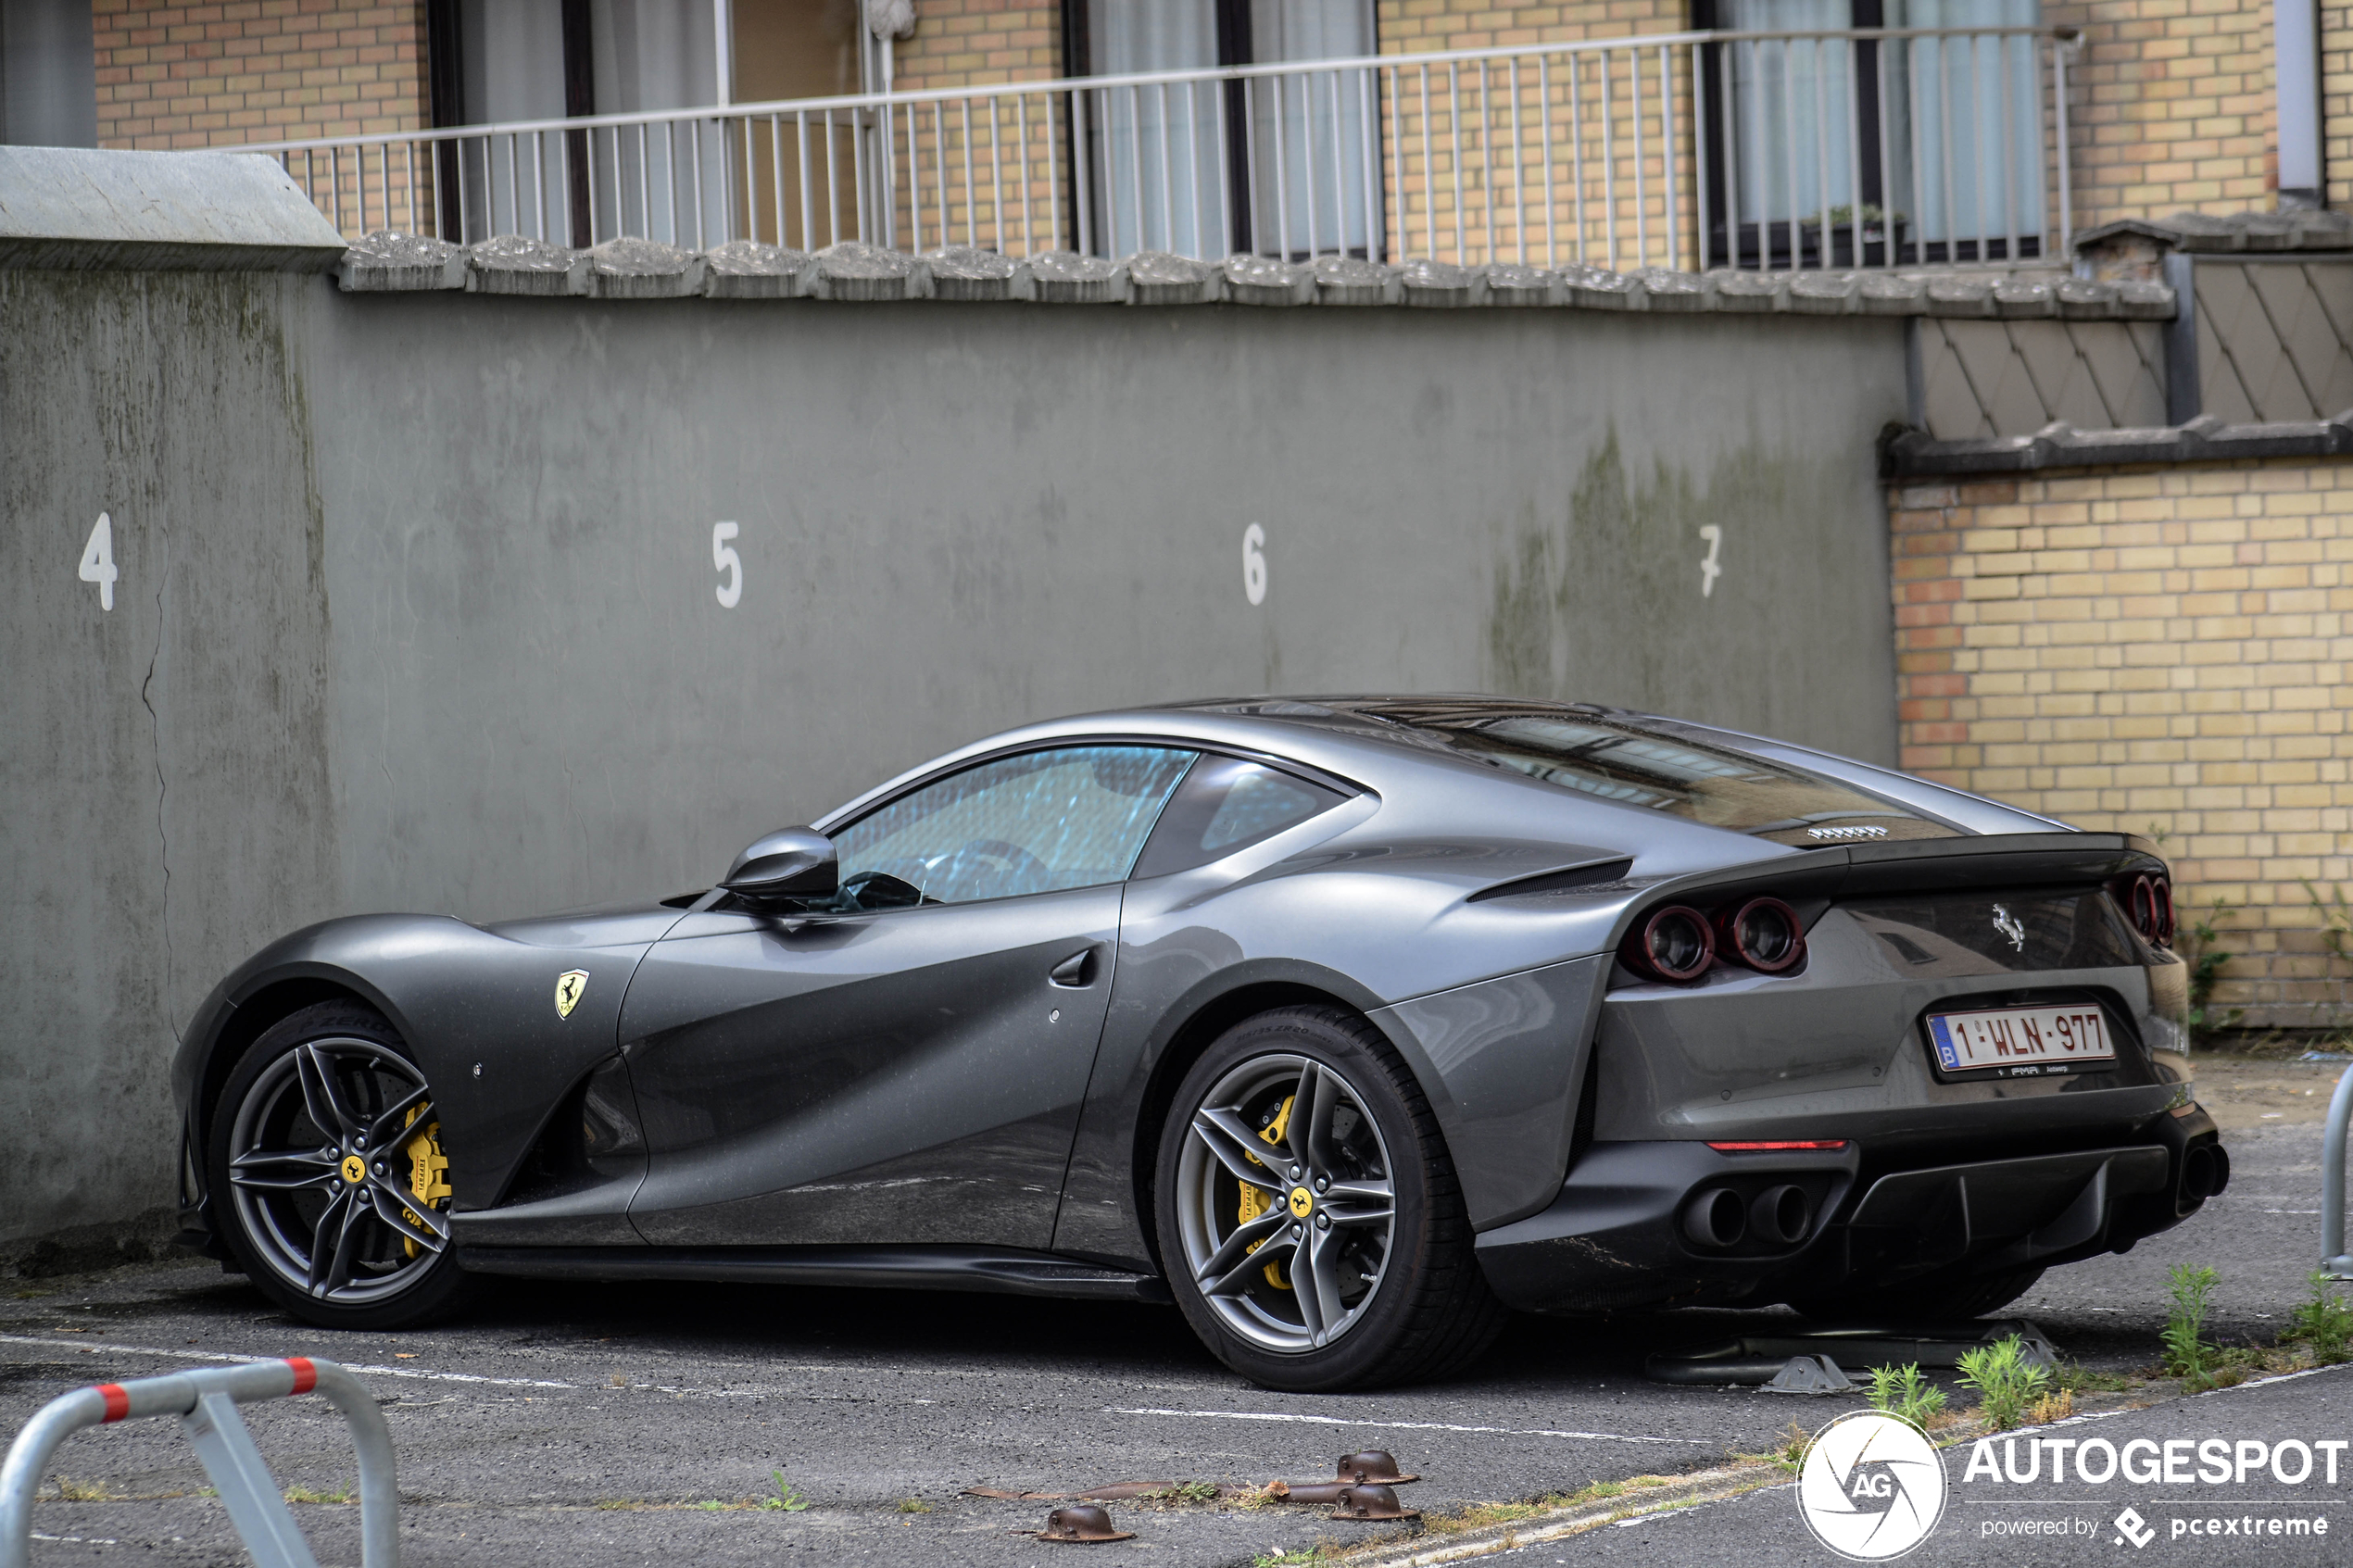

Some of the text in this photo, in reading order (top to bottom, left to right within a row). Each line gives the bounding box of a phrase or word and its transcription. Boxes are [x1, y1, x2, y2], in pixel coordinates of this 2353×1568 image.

[79, 512, 118, 611] 4
[712, 520, 743, 609] 5
[1241, 521, 1267, 606] 6
[1699, 525, 1721, 598] 7
[319, 1016, 388, 1033] ZERO
[1941, 1047, 1956, 1064] B
